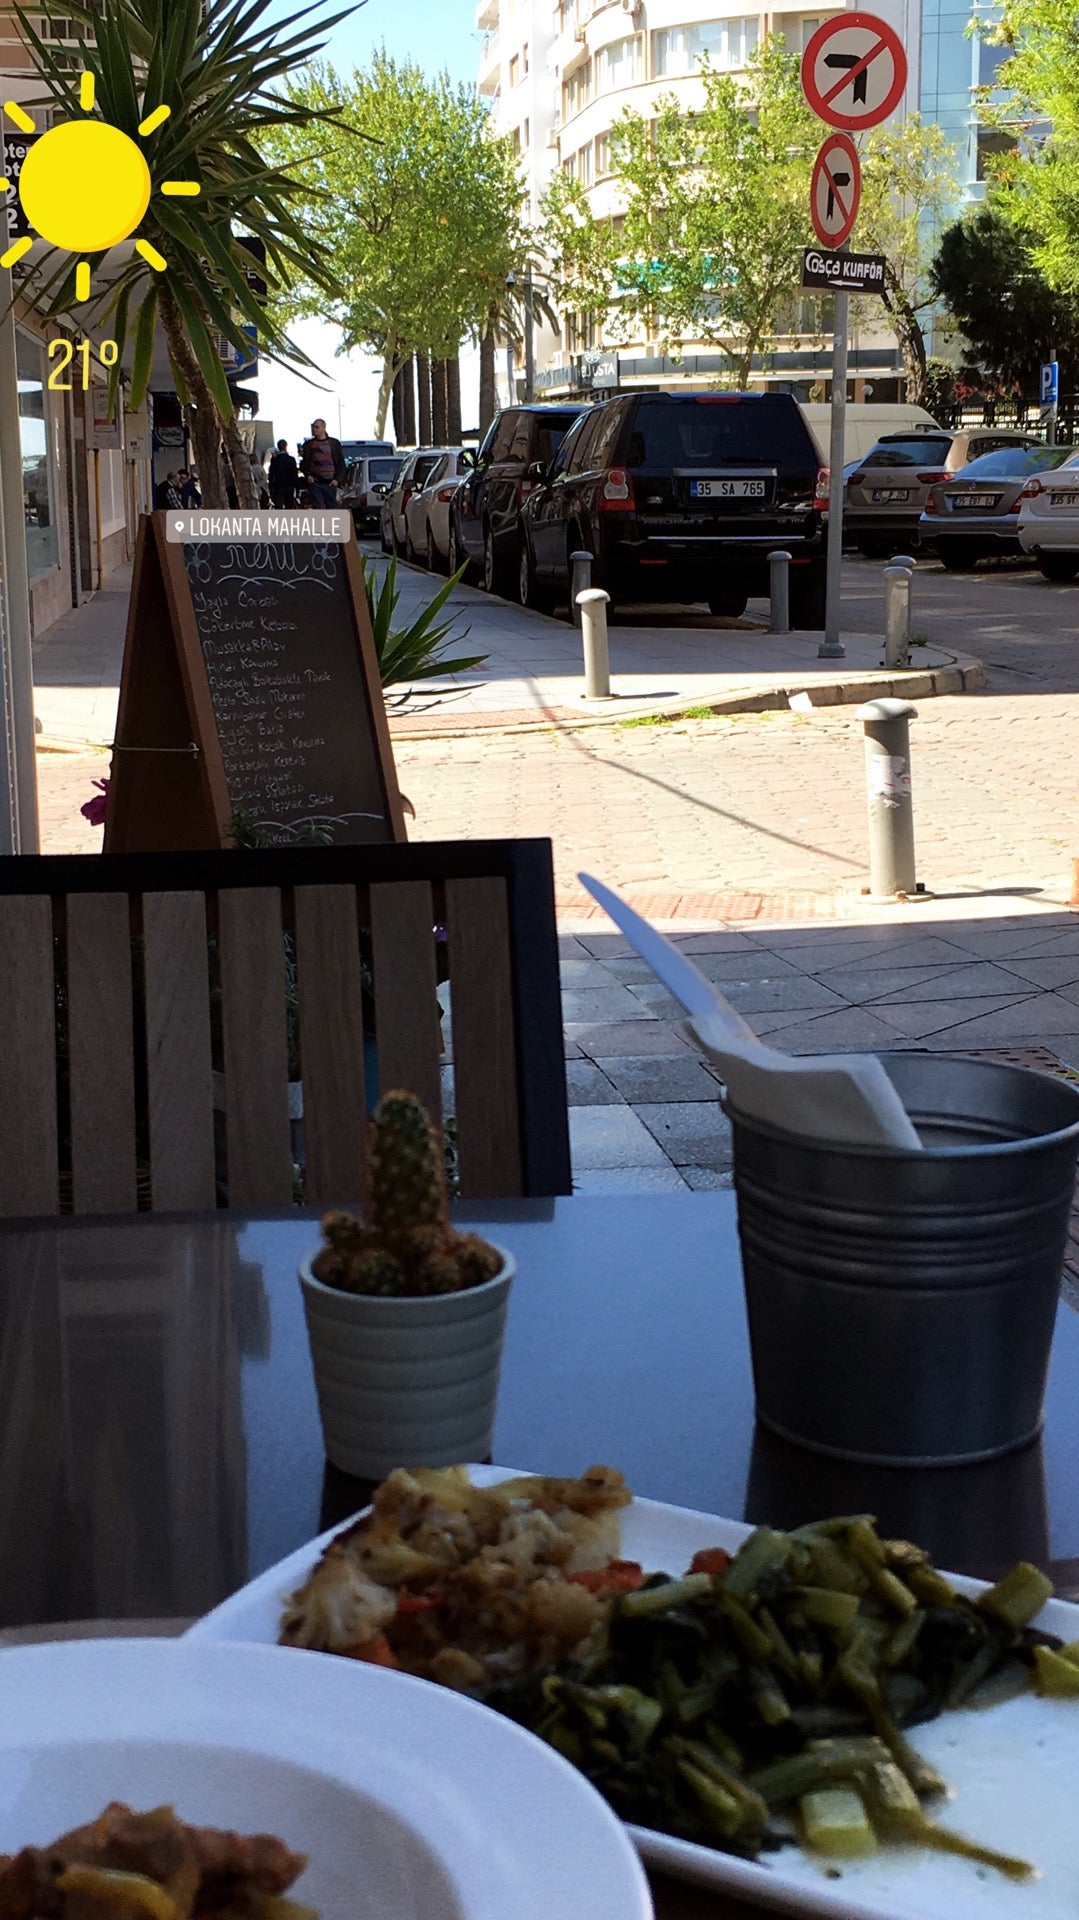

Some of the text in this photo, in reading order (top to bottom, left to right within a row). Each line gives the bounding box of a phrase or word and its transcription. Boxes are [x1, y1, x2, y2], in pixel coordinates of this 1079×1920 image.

[1042, 366, 1052, 401] P
[698, 482, 763, 496] 35 SA 765
